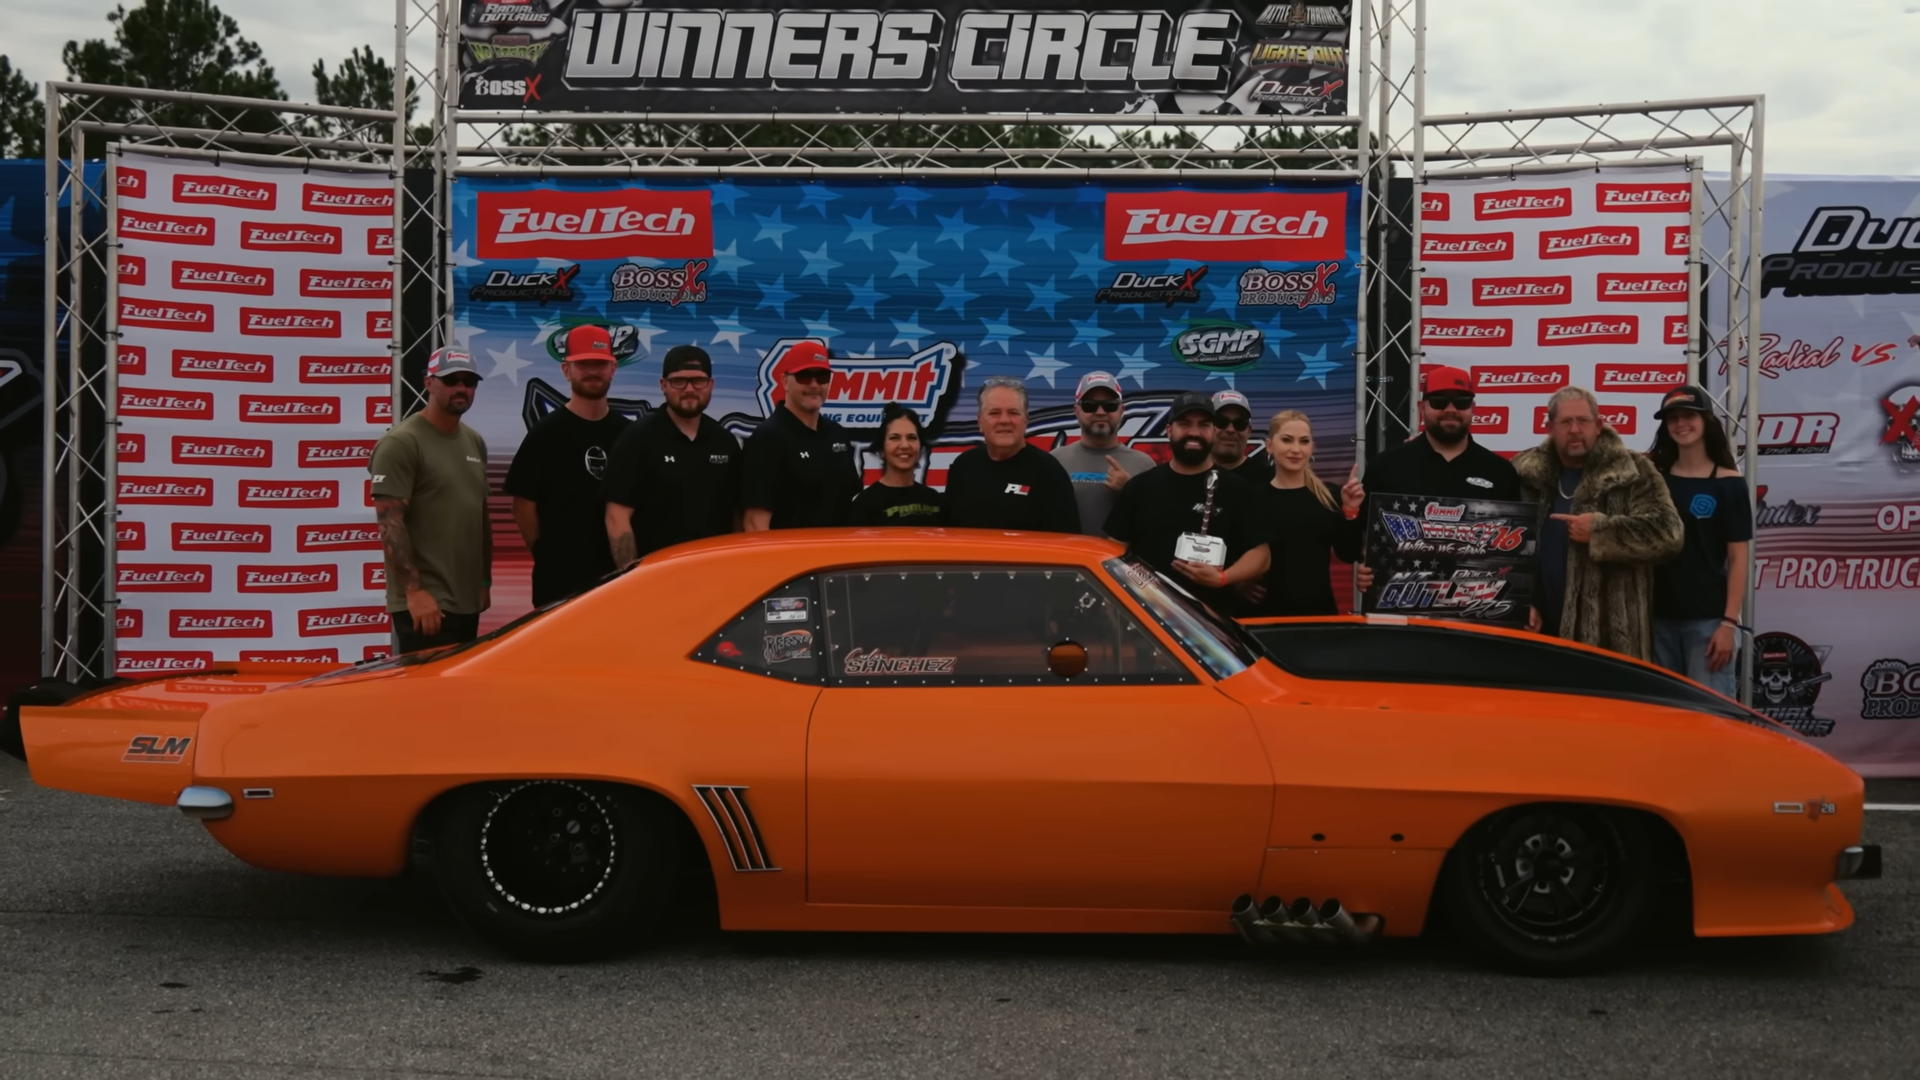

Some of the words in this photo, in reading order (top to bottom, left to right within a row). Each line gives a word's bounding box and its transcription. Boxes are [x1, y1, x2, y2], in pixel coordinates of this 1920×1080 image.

[484, 3, 534, 13] RADIAL
[478, 13, 550, 23] OUTLAWS
[565, 12, 934, 79] WINNERS
[950, 13, 1233, 81] CIRCLE
[1250, 43, 1309, 66] LIGHTS
[1312, 45, 1345, 70] OUT
[181, 181, 270, 200] FuelTech
[1482, 195, 1565, 214] FuelTech
[121, 215, 208, 236] FuelTech
[496, 206, 696, 239] FuelTech
[1124, 208, 1329, 241] FuelTech
[248, 228, 336, 245] FuelTech
[1546, 233, 1633, 253] FuelTech
[1422, 239, 1507, 255] FuelTech
[180, 268, 267, 286] FuelTech
[1480, 283, 1565, 300] FuelTech
[121, 304, 207, 322] FuelTech
[247, 314, 334, 330] FuelTech
[1422, 325, 1506, 340] FuelTech
[1545, 322, 1632, 340] FuelTech
[1178, 328, 1261, 355] SGMP
[180, 357, 267, 374] FuelTech
[1478, 372, 1562, 388] FuelTech
[120, 394, 207, 411] FuelTech
[246, 402, 334, 417] FuelTech
[180, 443, 266, 458] FuelTech
[306, 446, 373, 462] FuelTe
[119, 482, 207, 498] FuelTech
[246, 487, 332, 502] FuelTech
[180, 530, 264, 545] FuelTech
[1490, 525, 1528, 551] 16
[118, 570, 205, 586] FuelTech
[245, 571, 331, 587] FuelTech
[1775, 556, 1838, 589] PRO
[1843, 556, 1920, 590] TRUC
[1376, 580, 1508, 609] OUTLAW
[1459, 600, 1517, 619] 275
[178, 616, 265, 631] FuelTech
[306, 612, 390, 631] FuelTech
[118, 657, 206, 673] FuelTech
[845, 657, 957, 675] SANCHEZ
[126, 736, 192, 756] SLM
